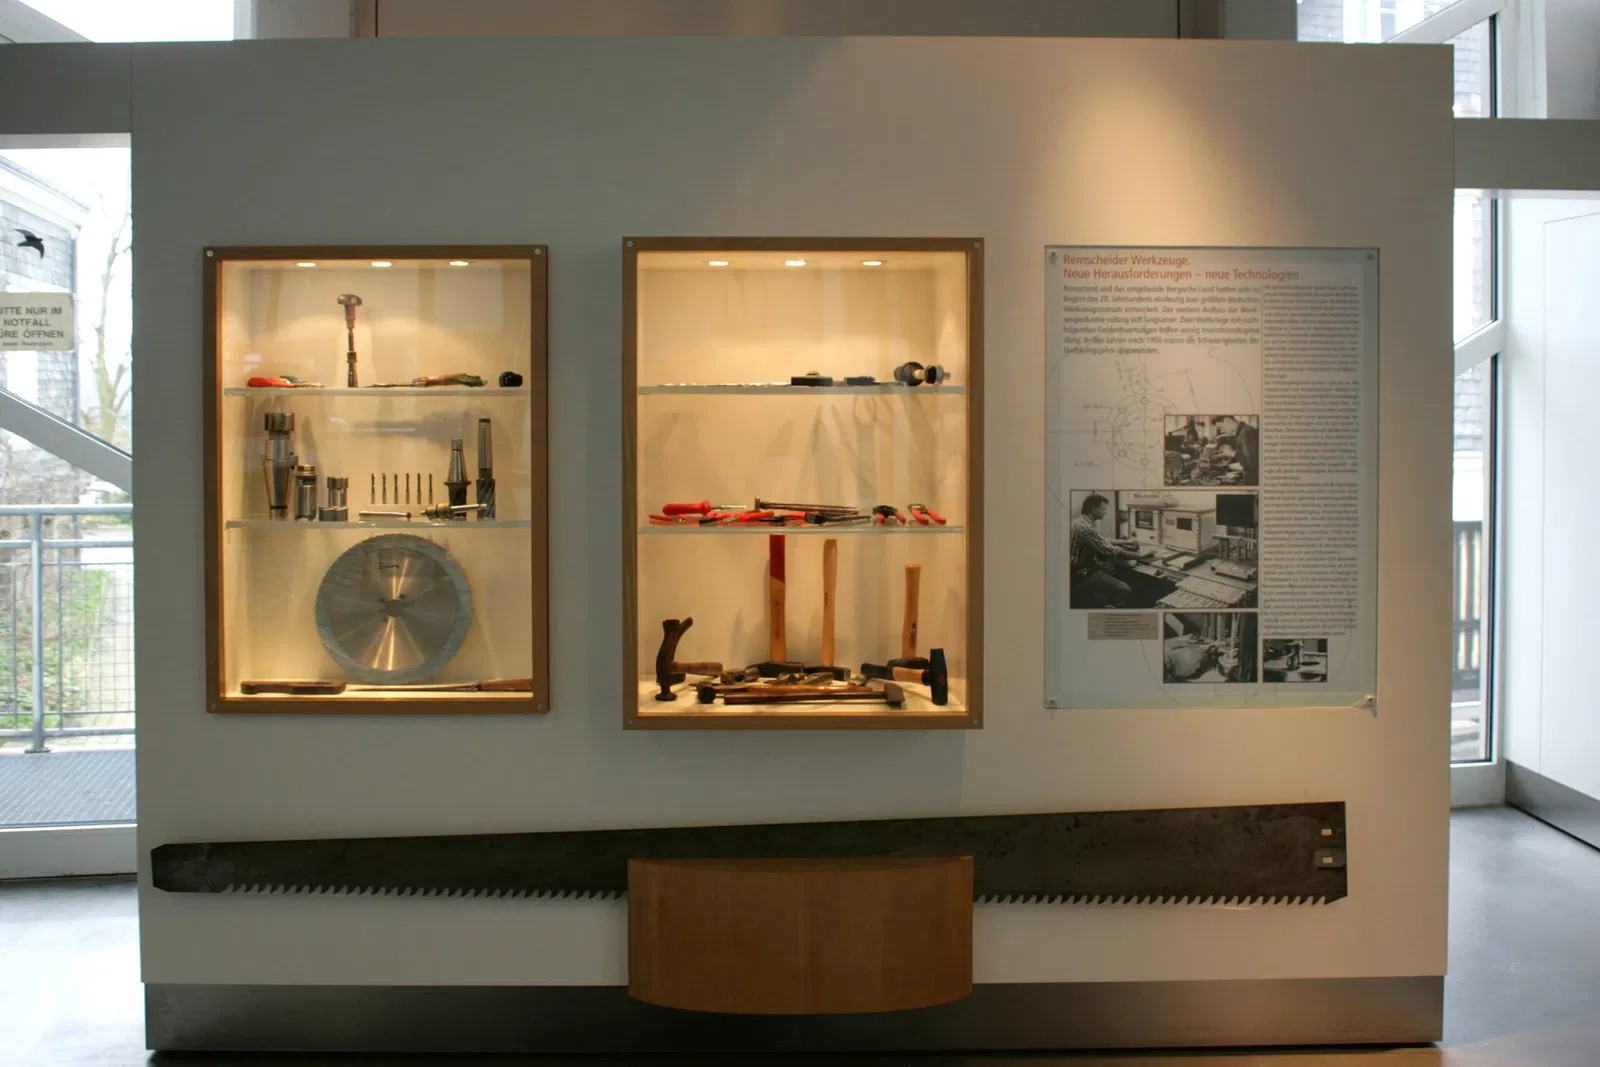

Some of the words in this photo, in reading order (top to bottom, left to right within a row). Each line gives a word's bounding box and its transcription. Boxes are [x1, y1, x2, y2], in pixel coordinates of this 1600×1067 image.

[1063, 254, 1129, 265] Remscheider
[1063, 267, 1091, 279] Neue
[1094, 267, 1192, 282] Herausforderungen
[1205, 270, 1230, 280] neue
[1232, 268, 1300, 282] Technologien
[26, 307, 47, 315] NUR
[4, 318, 52, 326] NOTFALL
